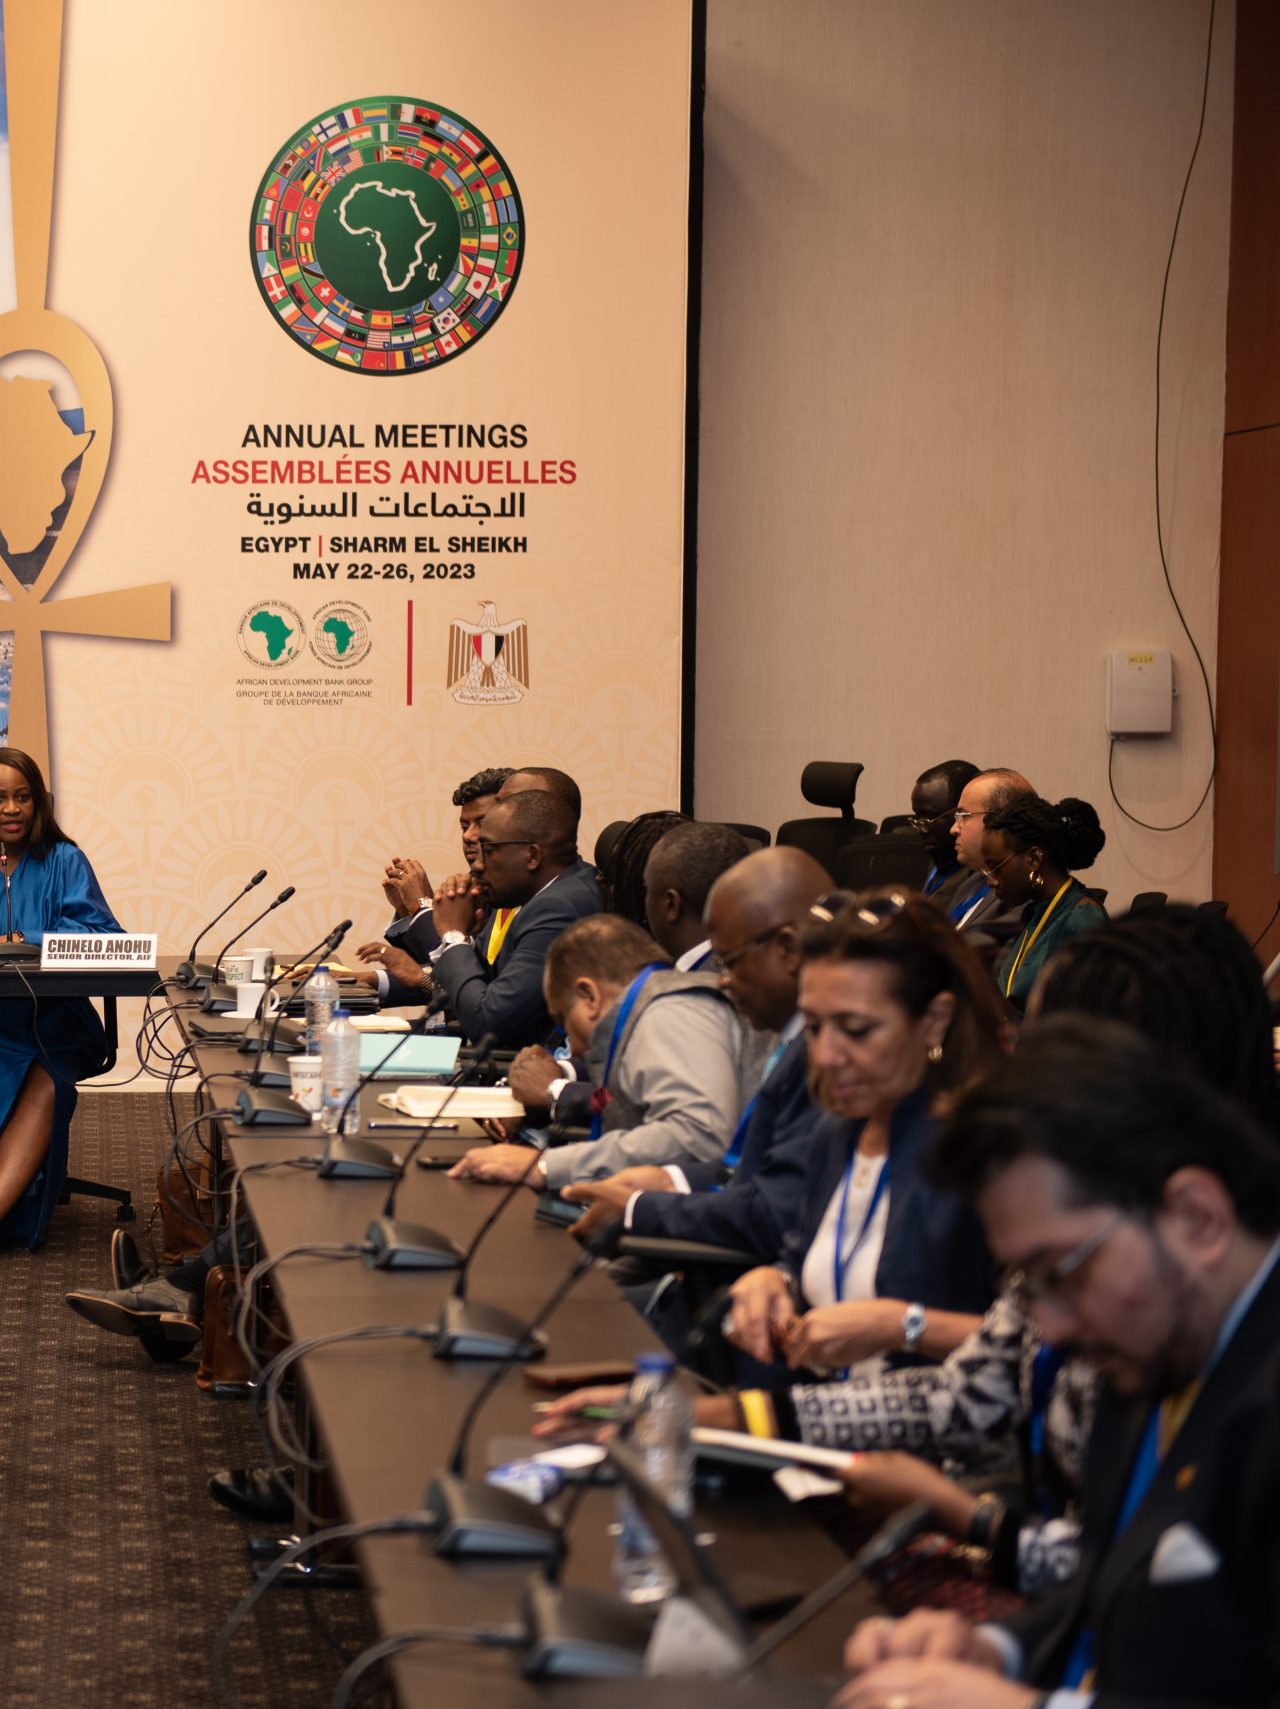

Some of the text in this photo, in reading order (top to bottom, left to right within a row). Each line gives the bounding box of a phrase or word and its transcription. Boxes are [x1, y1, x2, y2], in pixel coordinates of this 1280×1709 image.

[241, 423, 529, 449] ANNUAL MEETINGS
[191, 454, 578, 485] ASSEMBLÉES ANNUELLES
[246, 492, 526, 526] الاجتماعات السنوية
[240, 536, 528, 554] EGYPT SHARM EL SHEIKH
[292, 562, 476, 584] MAY 22-26, 2023
[236, 690, 373, 698] GROUPE DE LA BANQUE AFRICAINE
[263, 698, 274, 706] DE
[47, 939, 152, 954] CHINELO ANOHU
[84, 953, 135, 961] DIRECTOR,
